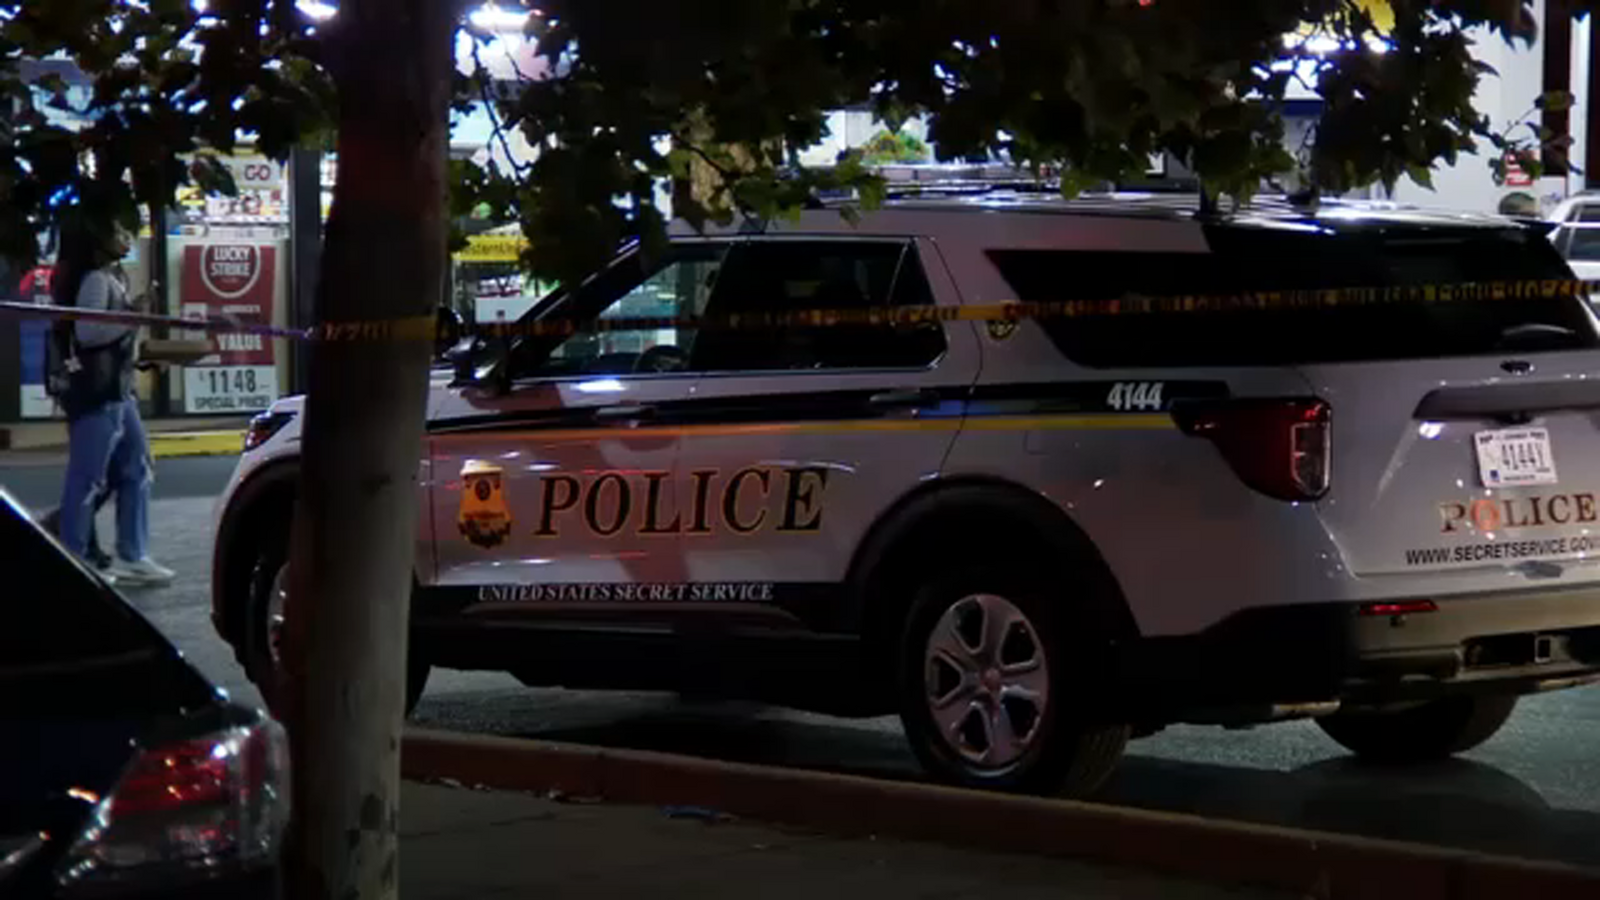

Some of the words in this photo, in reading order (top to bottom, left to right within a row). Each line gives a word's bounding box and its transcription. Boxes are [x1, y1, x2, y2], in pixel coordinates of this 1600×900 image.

[213, 246, 251, 261] LUCKY
[210, 262, 250, 276] STRIKE
[216, 334, 263, 351] VALUE
[1107, 382, 1164, 410] 4144
[533, 468, 828, 537] POLICE
[1439, 493, 1597, 533] POLICE
[478, 583, 542, 600] UNITED
[545, 583, 610, 600] STATES
[613, 583, 688, 600] SECRET
[690, 583, 774, 600] SERVICE
